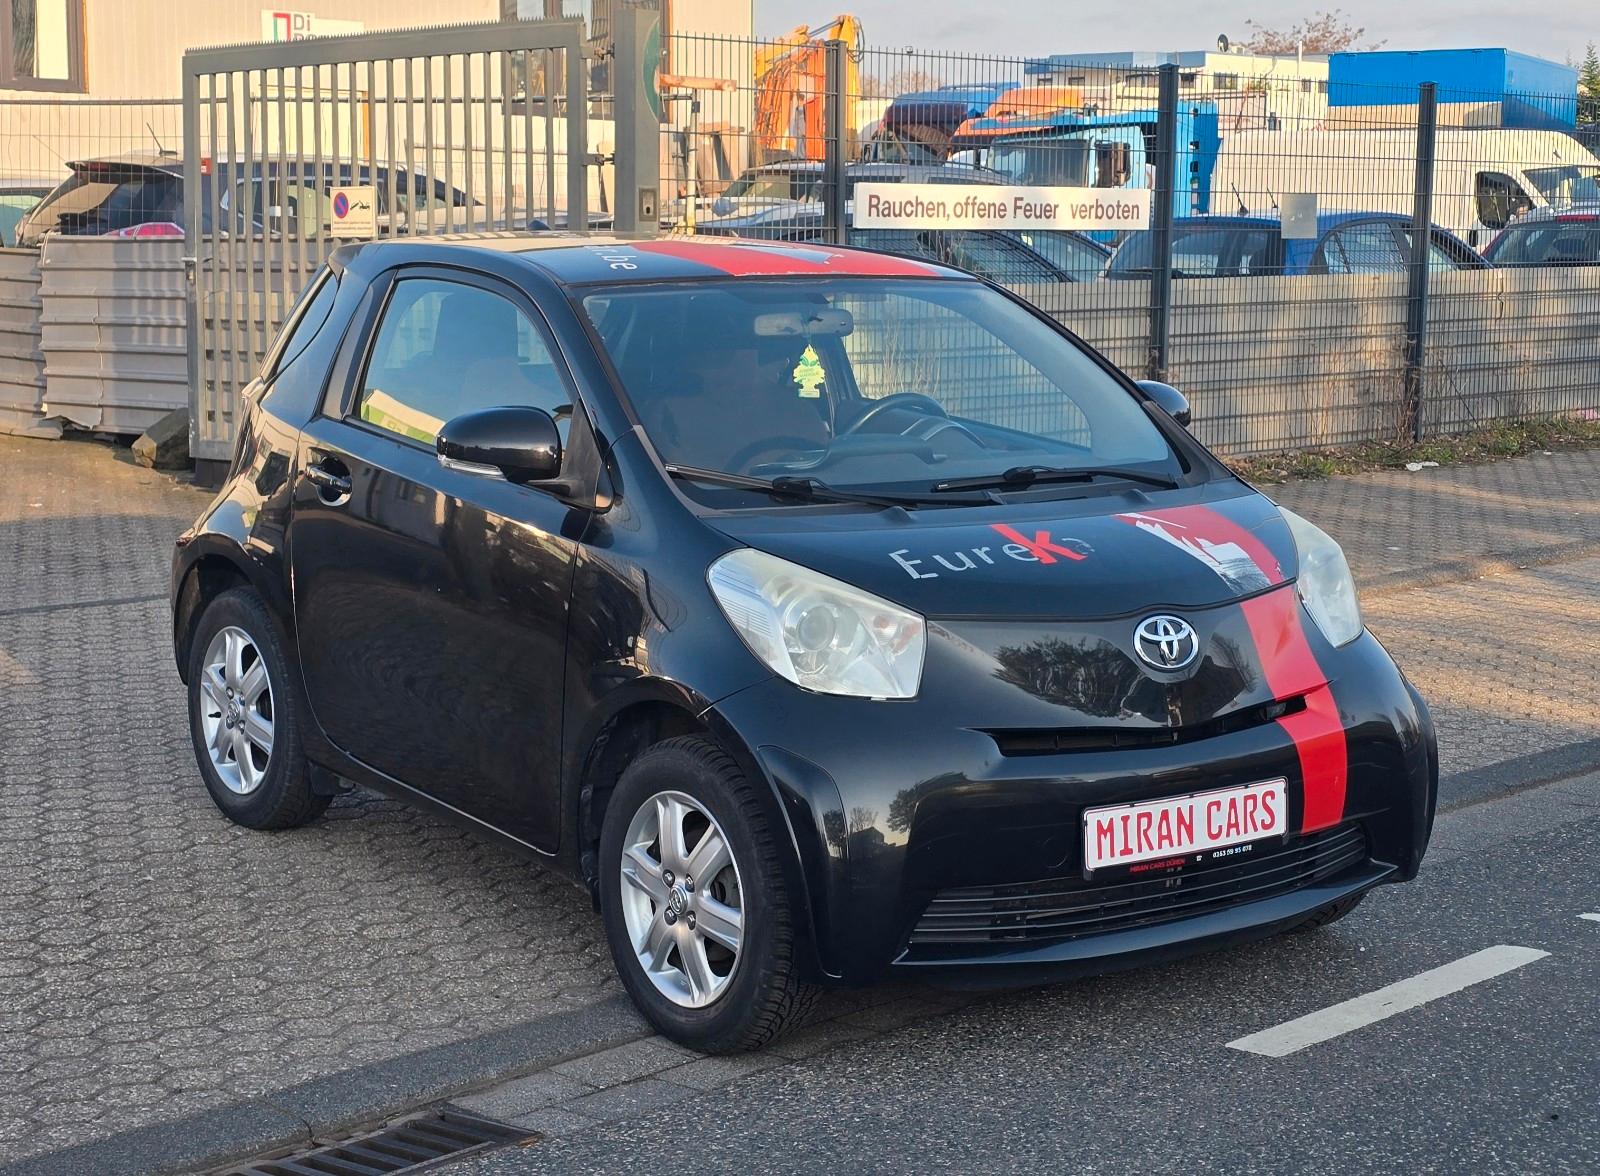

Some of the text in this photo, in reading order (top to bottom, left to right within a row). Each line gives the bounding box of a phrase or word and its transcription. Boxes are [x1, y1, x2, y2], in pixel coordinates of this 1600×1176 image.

[293, 13, 311, 32] Di
[868, 194, 1140, 221] Rauchen, offene Feuer verboten
[1096, 790, 1277, 861] MIRAN CARS
